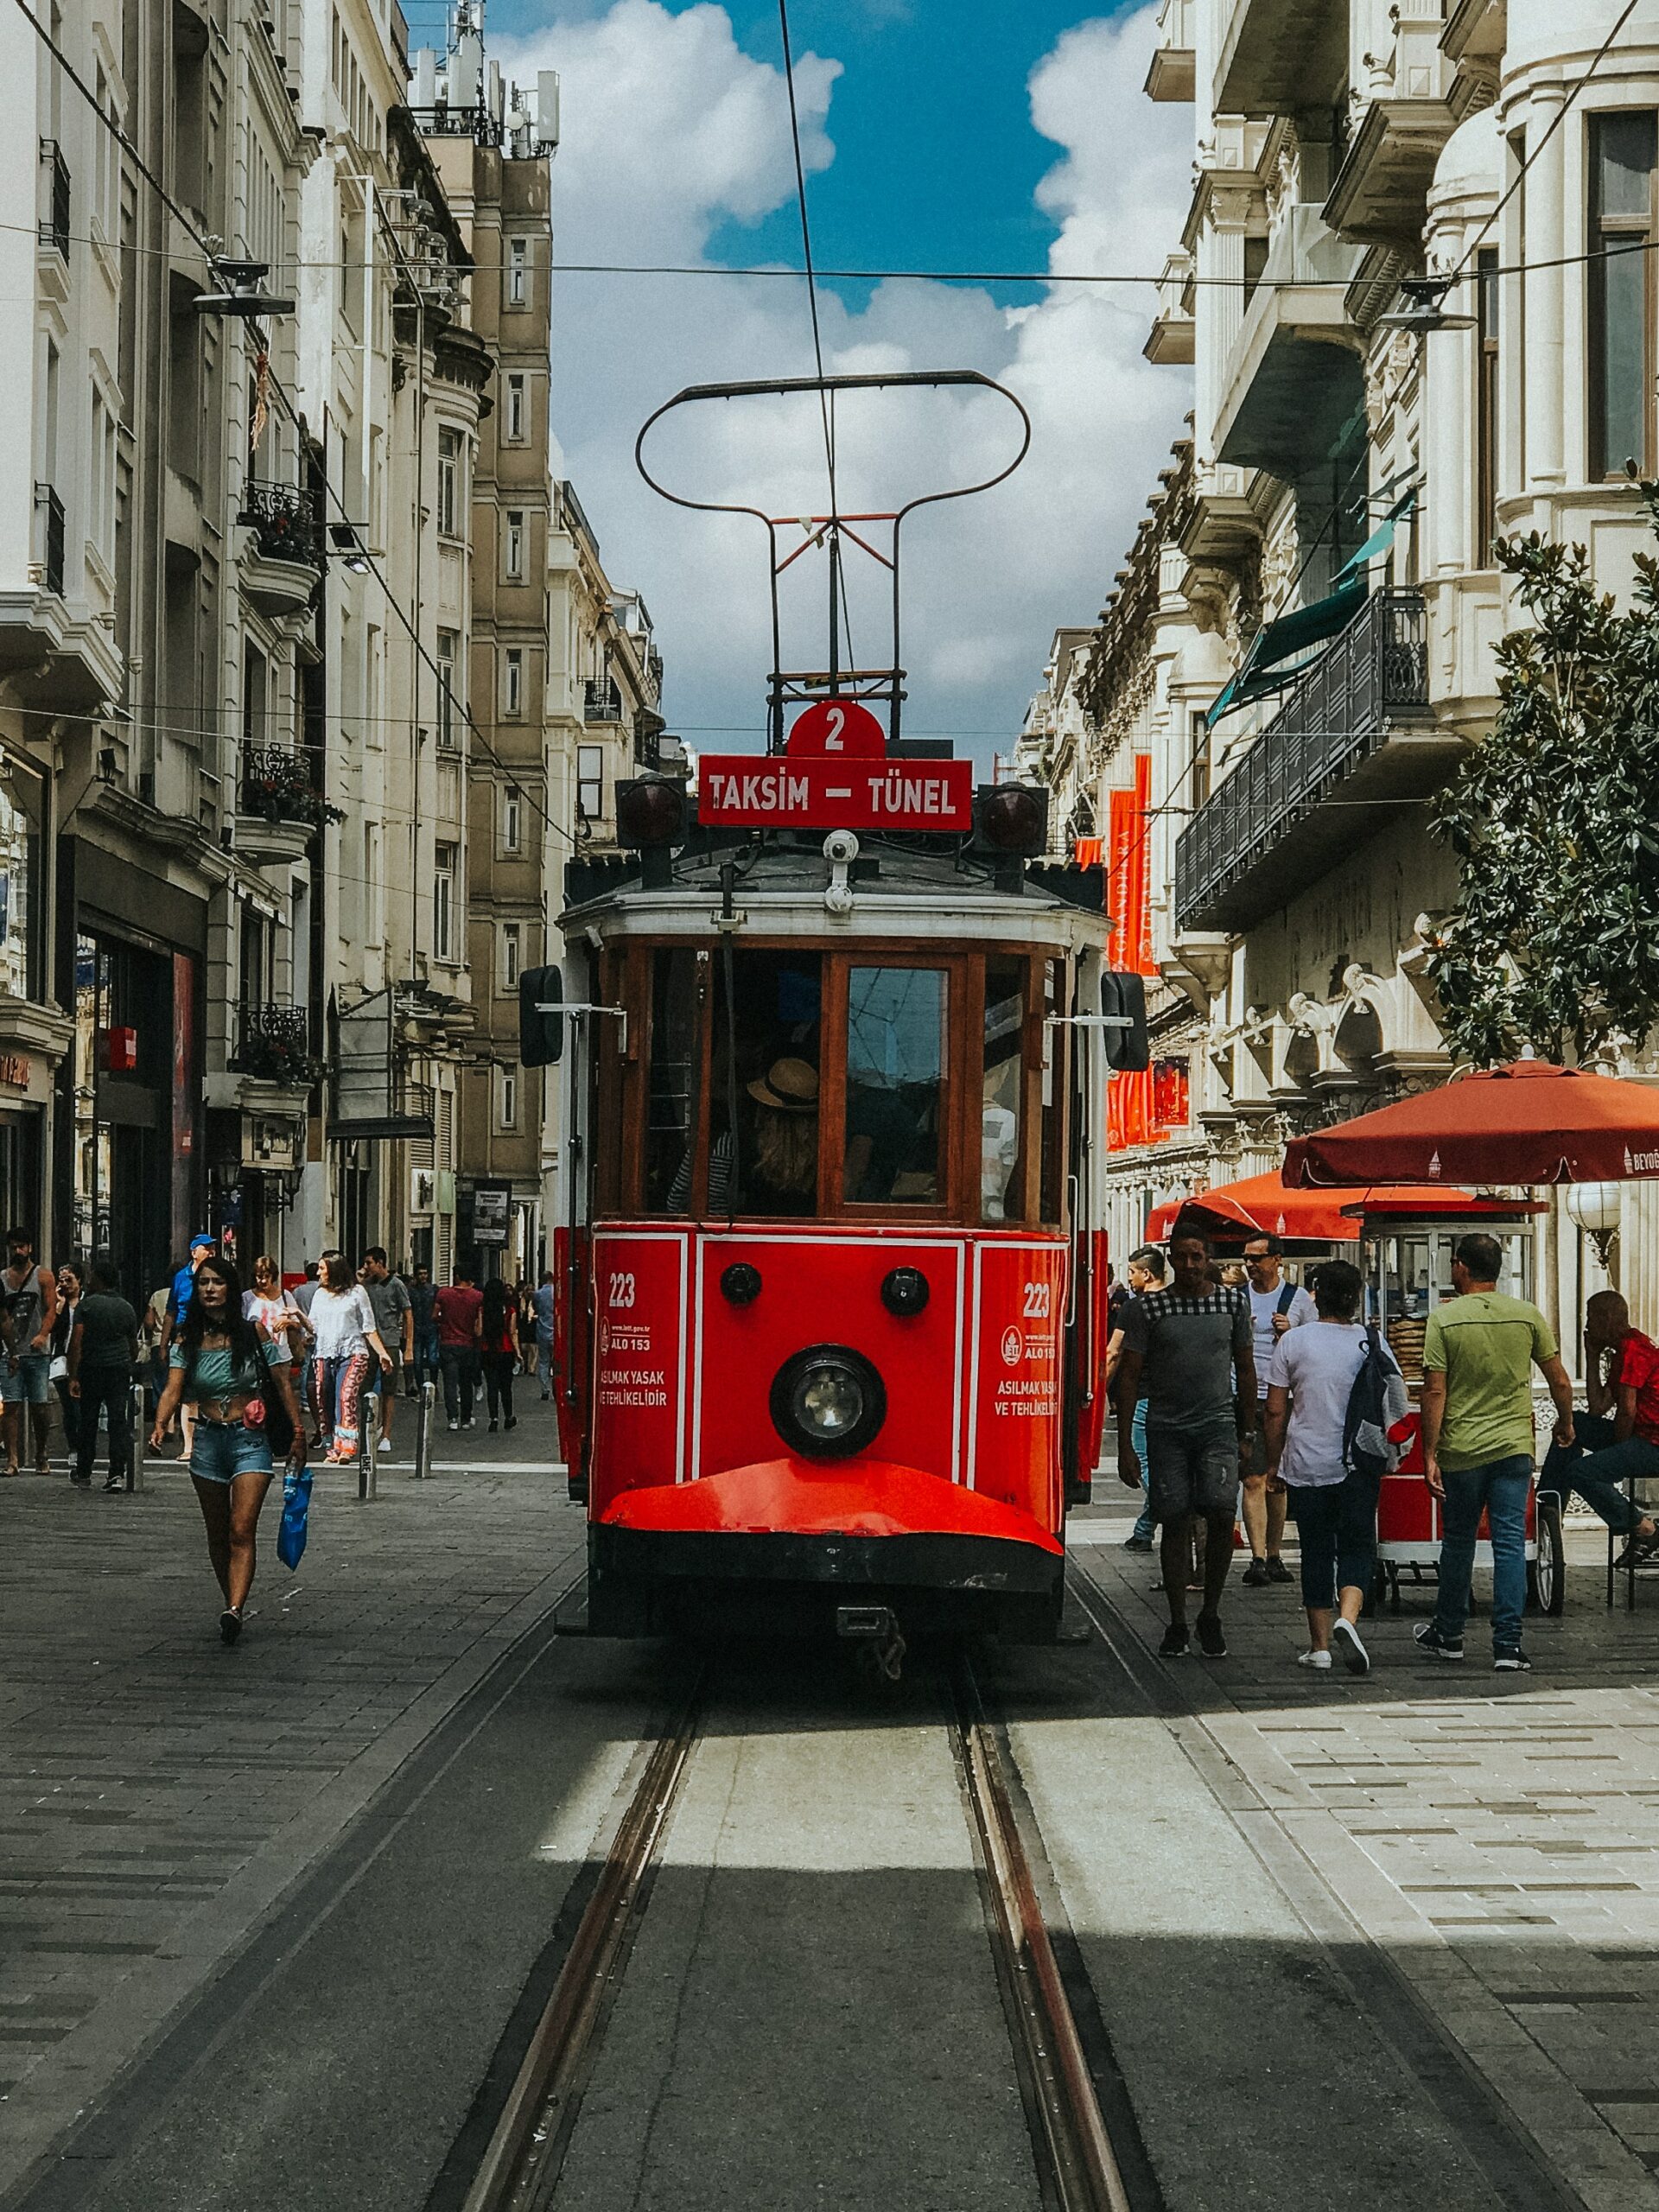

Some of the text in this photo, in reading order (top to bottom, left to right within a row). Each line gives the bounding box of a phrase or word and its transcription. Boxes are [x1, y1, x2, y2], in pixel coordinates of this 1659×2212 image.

[825, 708, 844, 751] 2
[709, 766, 809, 810] TAKSİM
[868, 769, 957, 814] TÜNEL
[609, 1273, 635, 1308] 223
[1023, 1282, 1050, 1318] 223
[611, 1338, 628, 1350] ALO
[631, 1339, 651, 1351] 153
[1025, 1348, 1043, 1359] ALO
[631, 1370, 664, 1385] YASAK
[997, 1381, 1040, 1395] ASILMAK
[607, 1389, 667, 1407] TEHLİKELİDİR
[995, 1402, 1009, 1416] VE
